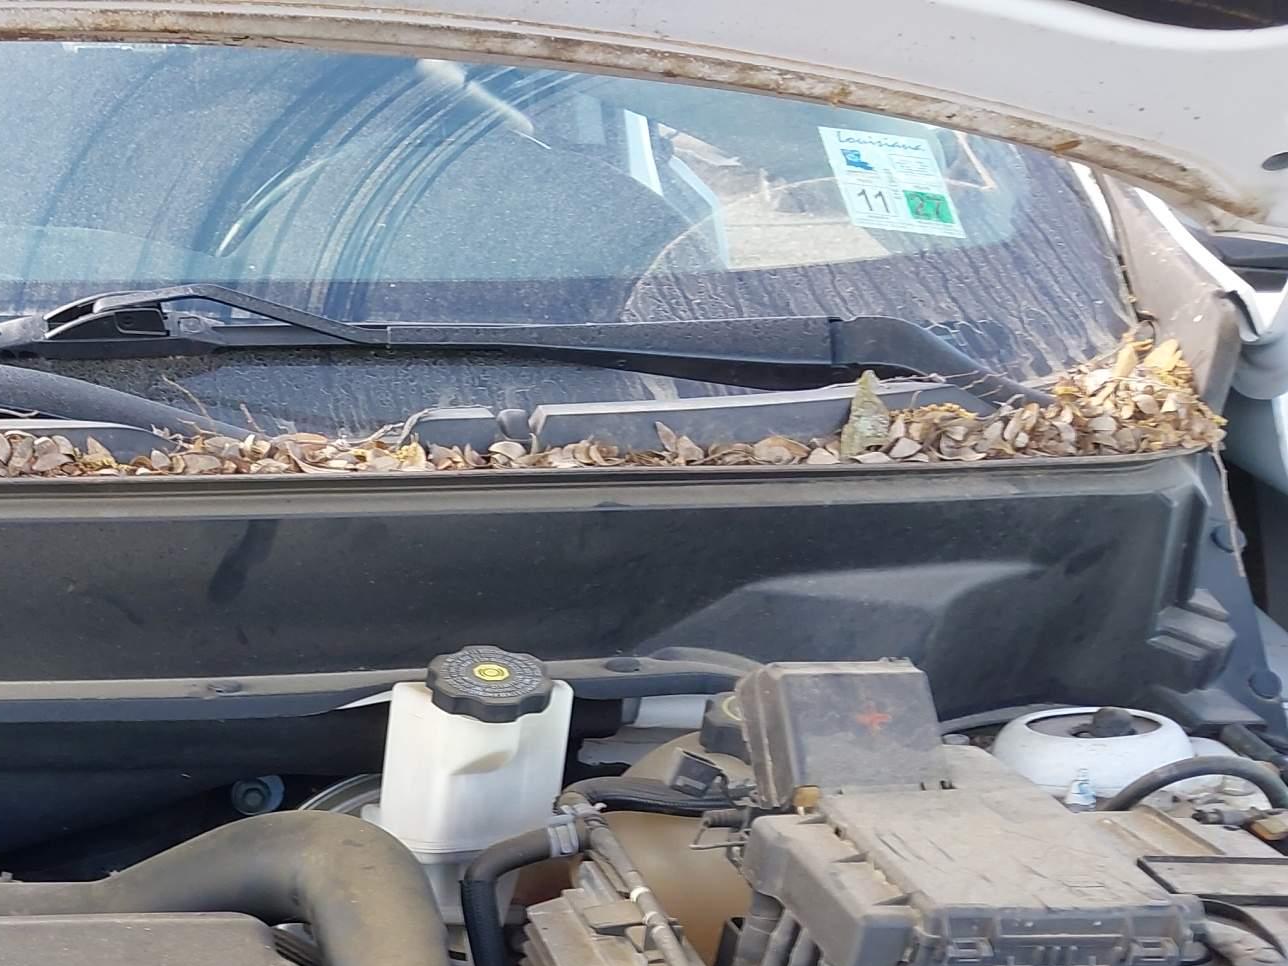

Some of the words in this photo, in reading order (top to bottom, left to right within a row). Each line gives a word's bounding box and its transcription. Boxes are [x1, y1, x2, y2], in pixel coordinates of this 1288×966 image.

[837, 131, 926, 152] Louisiana
[857, 188, 890, 214] 11
[909, 193, 945, 221] 27
